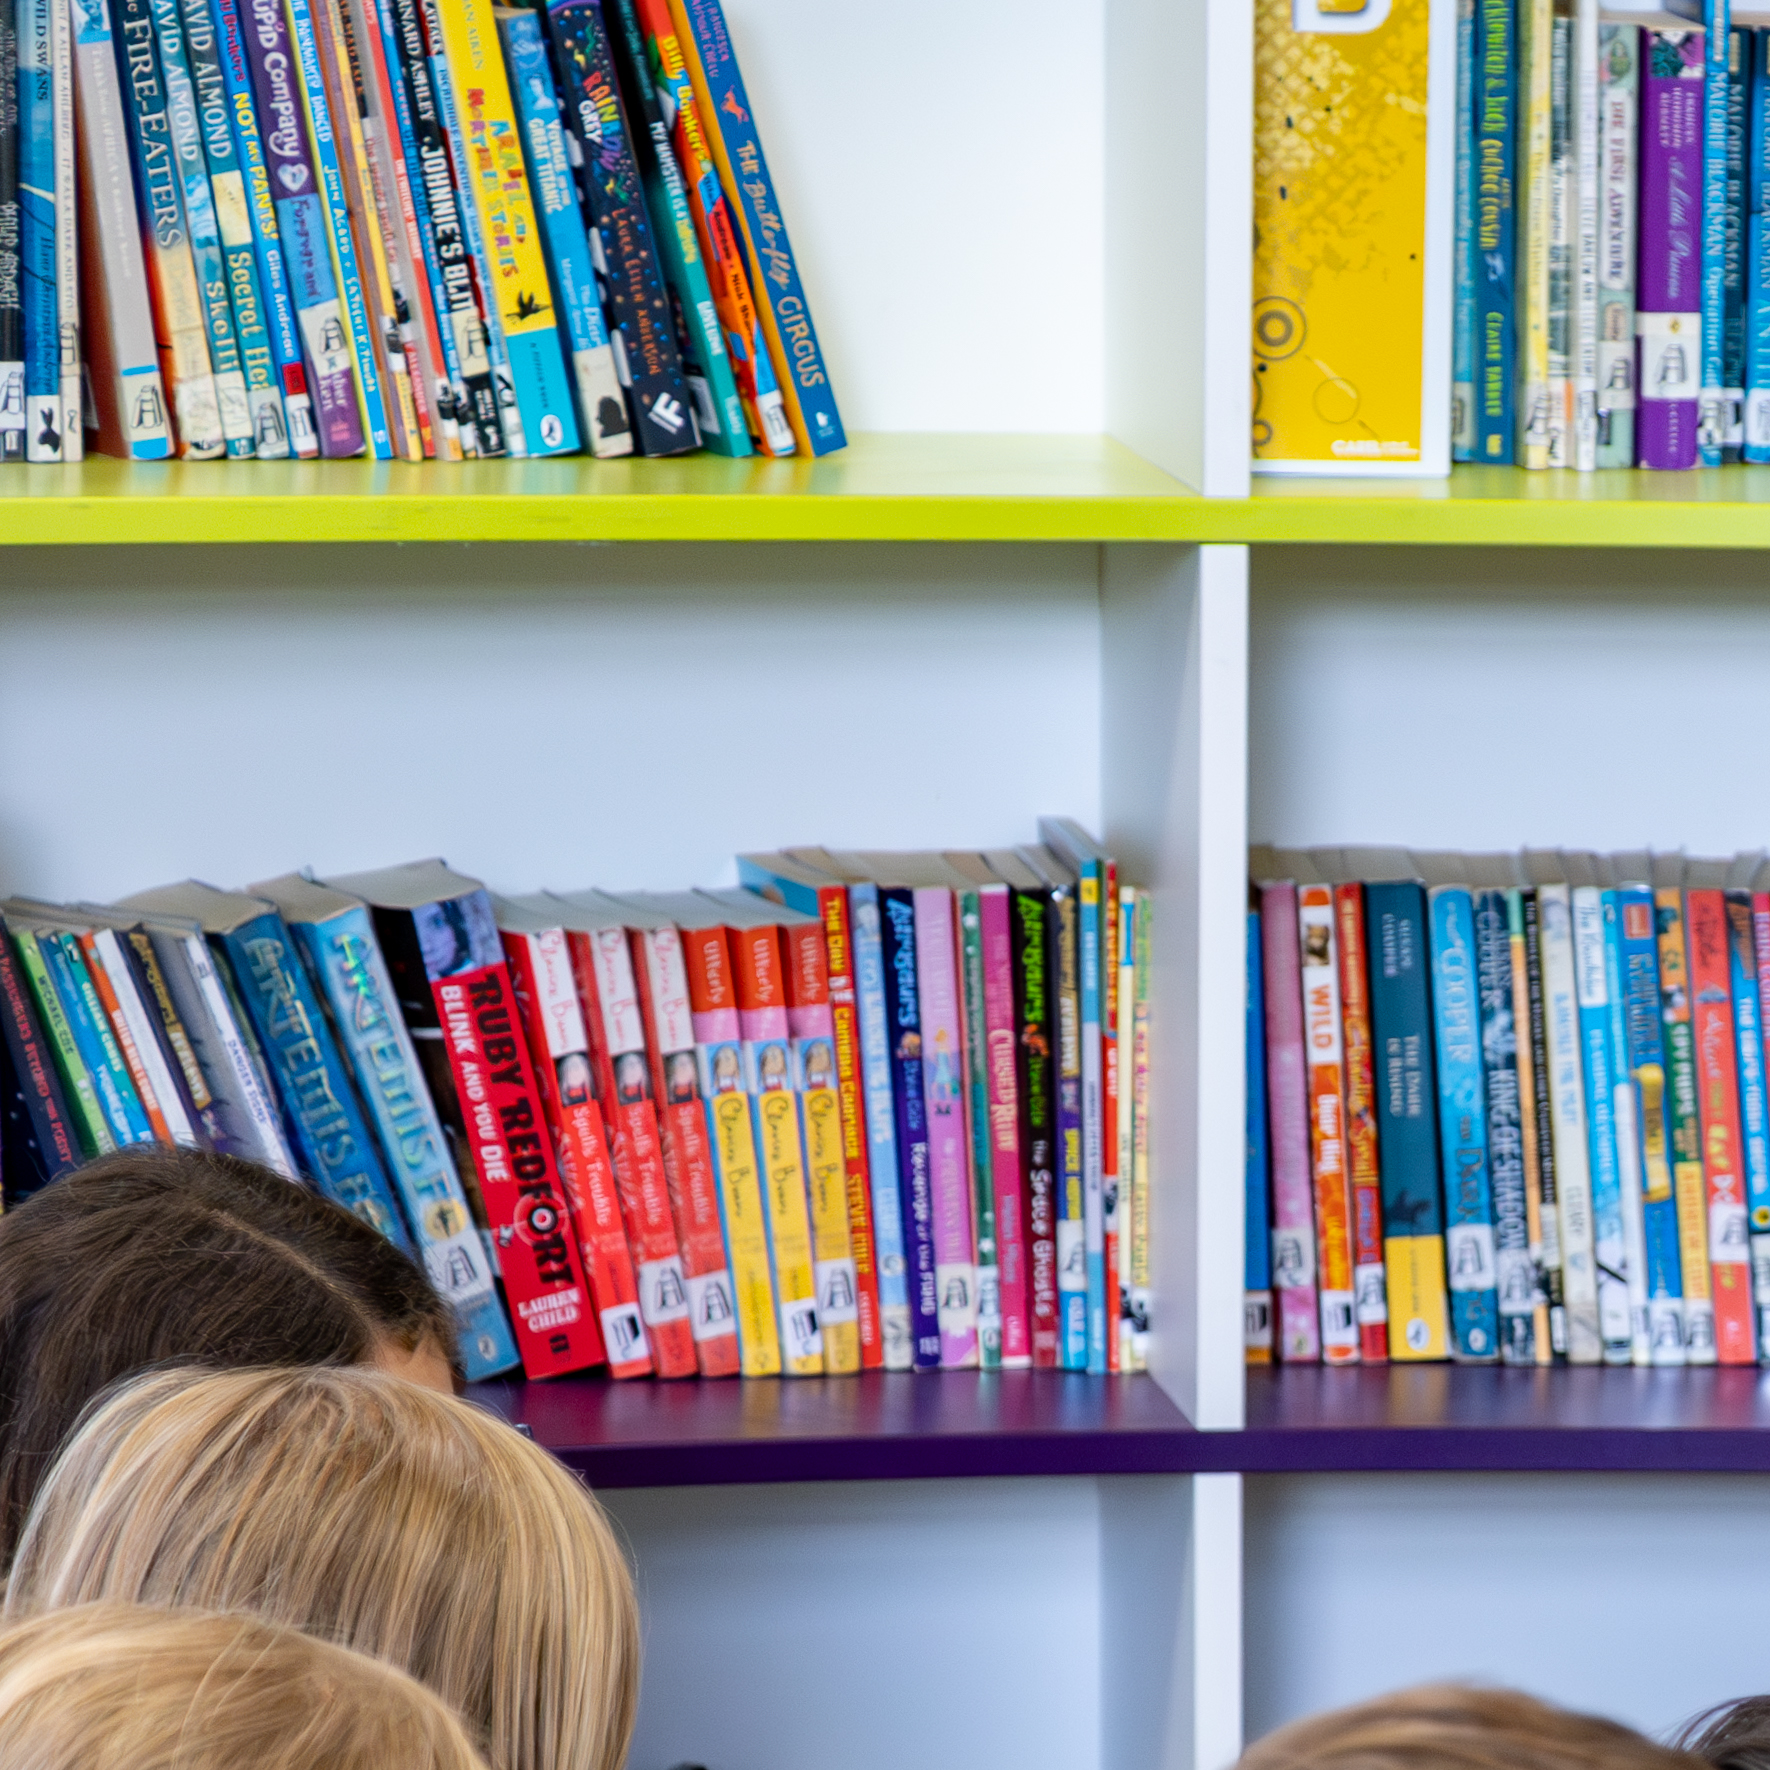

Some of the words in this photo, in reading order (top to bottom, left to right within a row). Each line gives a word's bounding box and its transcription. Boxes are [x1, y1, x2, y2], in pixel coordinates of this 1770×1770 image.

[164, 61, 201, 162] ALMOND
[194, 61, 233, 159] ALMOND
[264, 51, 300, 156] Company
[409, 58, 437, 122] ASHLEY
[578, 100, 604, 146] GREY
[581, 70, 624, 172] RAINBOW
[1707, 71, 1728, 152] MALORIE
[123, 15, 183, 249] FIRE-EATERS
[528, 117, 550, 161] GREAT
[650, 120, 666, 141] MY
[736, 139, 761, 176] THE
[233, 93, 258, 137] NOT
[249, 165, 280, 241] PANTS!
[536, 162, 564, 215] TITANIC
[655, 141, 684, 197] HAMSTER
[421, 143, 465, 260] JOHNNIE'S
[1477, 197, 1501, 250] COUSIN
[1706, 157, 1728, 257] BLACKMAN
[742, 179, 793, 292] Butterfly
[227, 252, 264, 340] Secret
[265, 249, 282, 289] Giles
[274, 293, 296, 358] Andreae
[701, 938, 726, 1005] Utterly
[752, 937, 773, 1003] Utterly
[799, 934, 820, 1001] Utterly
[885, 898, 918, 1028] Astrosaurs
[1018, 895, 1046, 1021] Astrosaurs
[0, 957, 31, 1041] PASSENGERS
[23, 1042, 51, 1099] BEYOND
[36, 975, 63, 1029] MICHAEL
[81, 981, 113, 1029] GILLIAN
[99, 1030, 123, 1074] CROSS
[439, 985, 474, 1054] BLINK
[1308, 983, 1334, 1051] WILD
[1441, 947, 1473, 1064] COOPER
[226, 1039, 254, 1089] DANGER
[333, 931, 444, 1178] ARTEMIS
[458, 1060, 485, 1100] AND
[988, 1029, 1016, 1101] CURSED
[470, 1102, 495, 1141] YOU
[719, 1096, 753, 1161] Clarice
[763, 1096, 797, 1160] Clarice
[808, 1094, 836, 1160] Clarice
[1488, 1068, 1518, 1123] KING
[466, 972, 528, 1090] RUBY
[498, 1096, 577, 1287] REDFORT
[480, 1143, 508, 1184] DIE
[584, 1163, 612, 1226] Trouble
[632, 1163, 661, 1226] Trouble
[687, 1163, 711, 1226] Trouble
[729, 1167, 755, 1220] Bean
[773, 1166, 800, 1218] Bean
[817, 1164, 842, 1216] Bean
[910, 1141, 932, 1210] Revenge
[1030, 1169, 1053, 1235] Space
[1497, 1153, 1525, 1251] SHADOW
[516, 1287, 580, 1319] LAUREN
[1032, 1240, 1056, 1318] Ghosts
[525, 1306, 578, 1332] CHILD
